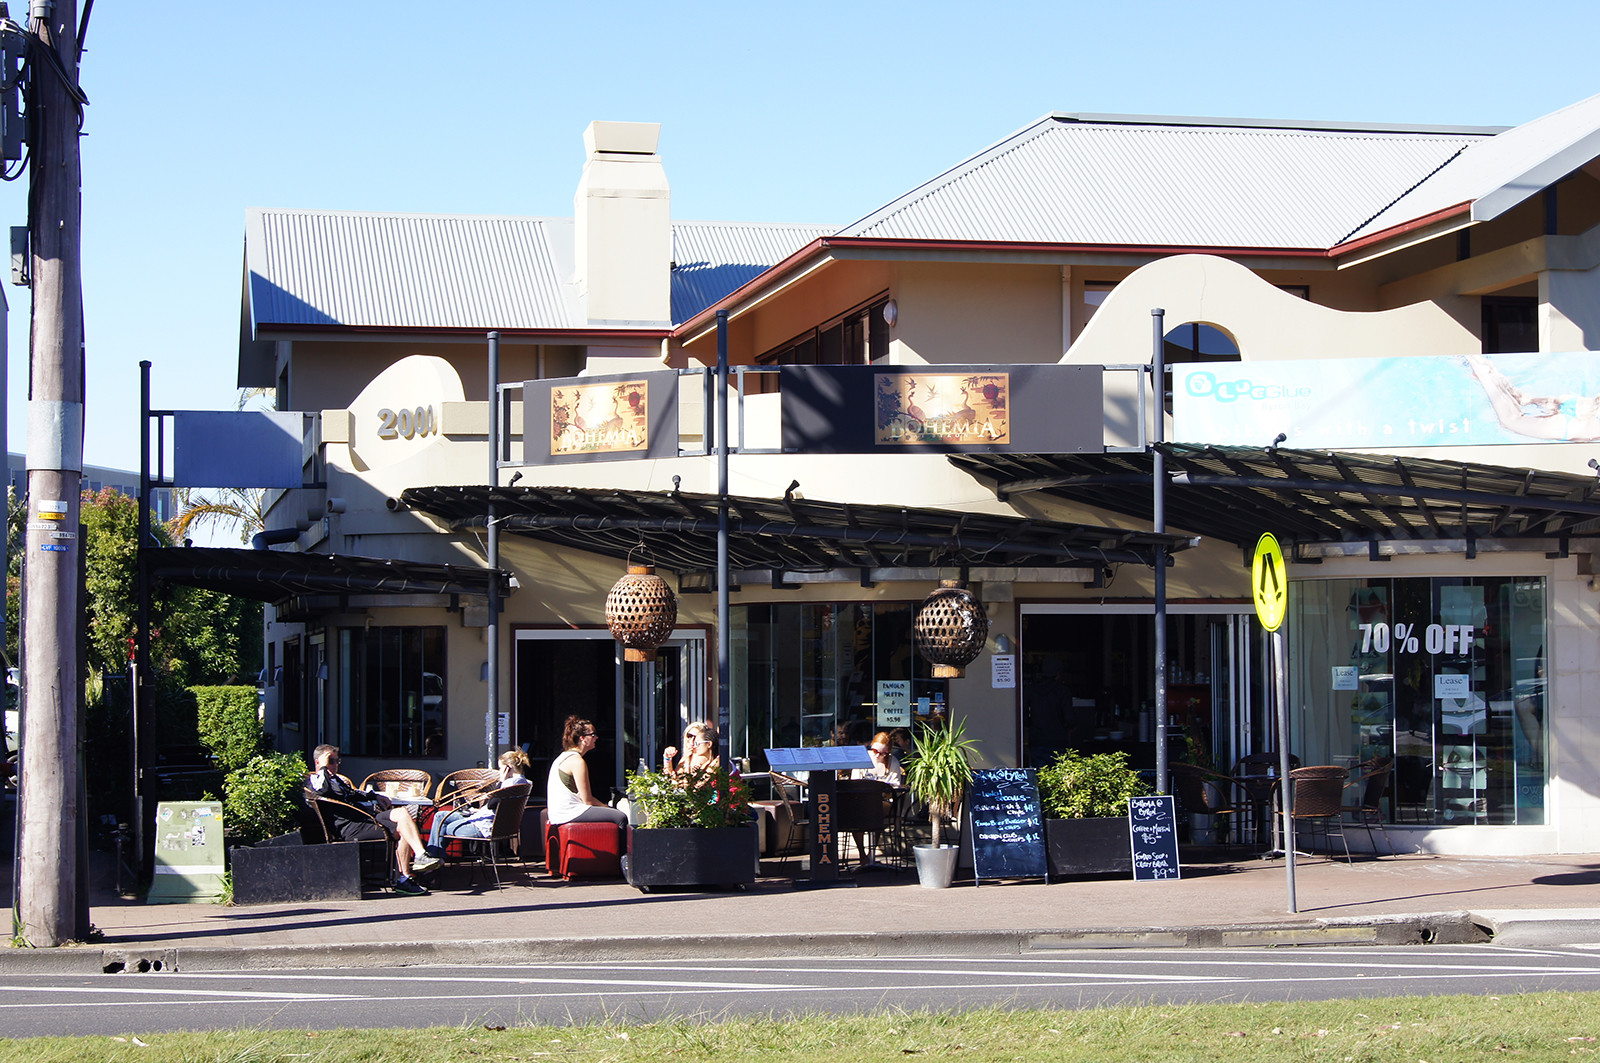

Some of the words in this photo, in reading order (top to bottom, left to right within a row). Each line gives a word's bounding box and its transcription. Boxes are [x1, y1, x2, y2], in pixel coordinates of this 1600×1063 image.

[377, 404, 434, 438] 2000
[889, 417, 999, 438] BOHEMIA
[1316, 418, 1368, 436] with
[1383, 422, 1393, 435] a
[1408, 417, 1471, 434] twist
[561, 425, 641, 449] BOHEMIA
[1425, 623, 1474, 655] OFF
[1335, 668, 1354, 677] Lease
[1439, 676, 1463, 685] Lease
[818, 793, 832, 865] BOHEMIA
